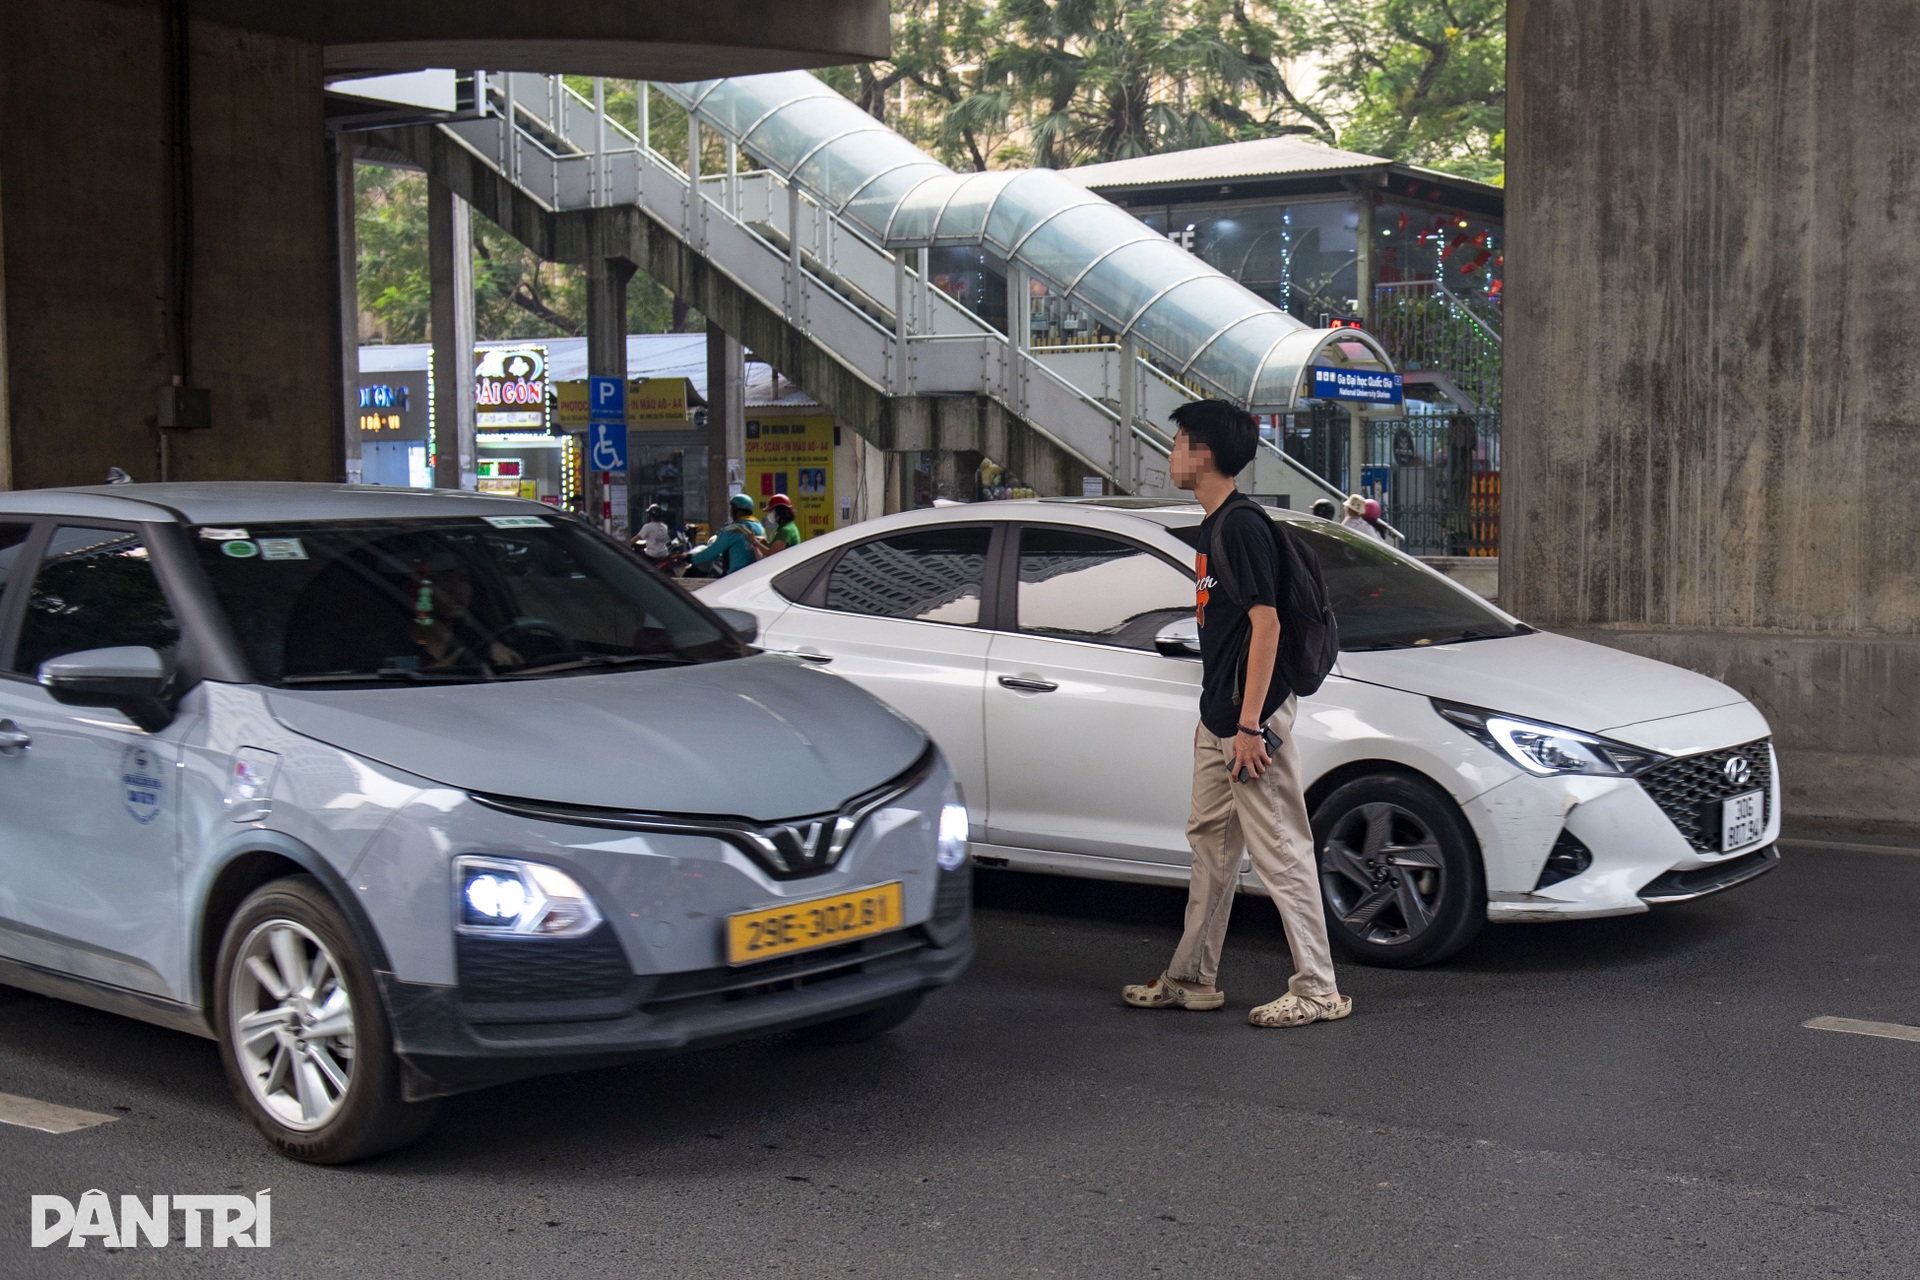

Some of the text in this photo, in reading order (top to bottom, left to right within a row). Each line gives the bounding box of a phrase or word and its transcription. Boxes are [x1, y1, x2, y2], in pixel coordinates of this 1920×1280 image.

[1337, 373, 1393, 389] Ga Đại học Quốc Gia
[600, 382, 615, 405] P
[1339, 388, 1391, 399] National University Station
[639, 397, 656, 410] MÀU
[672, 398, 682, 409] A4
[764, 441, 780, 452] SCAN
[820, 441, 828, 451] A4
